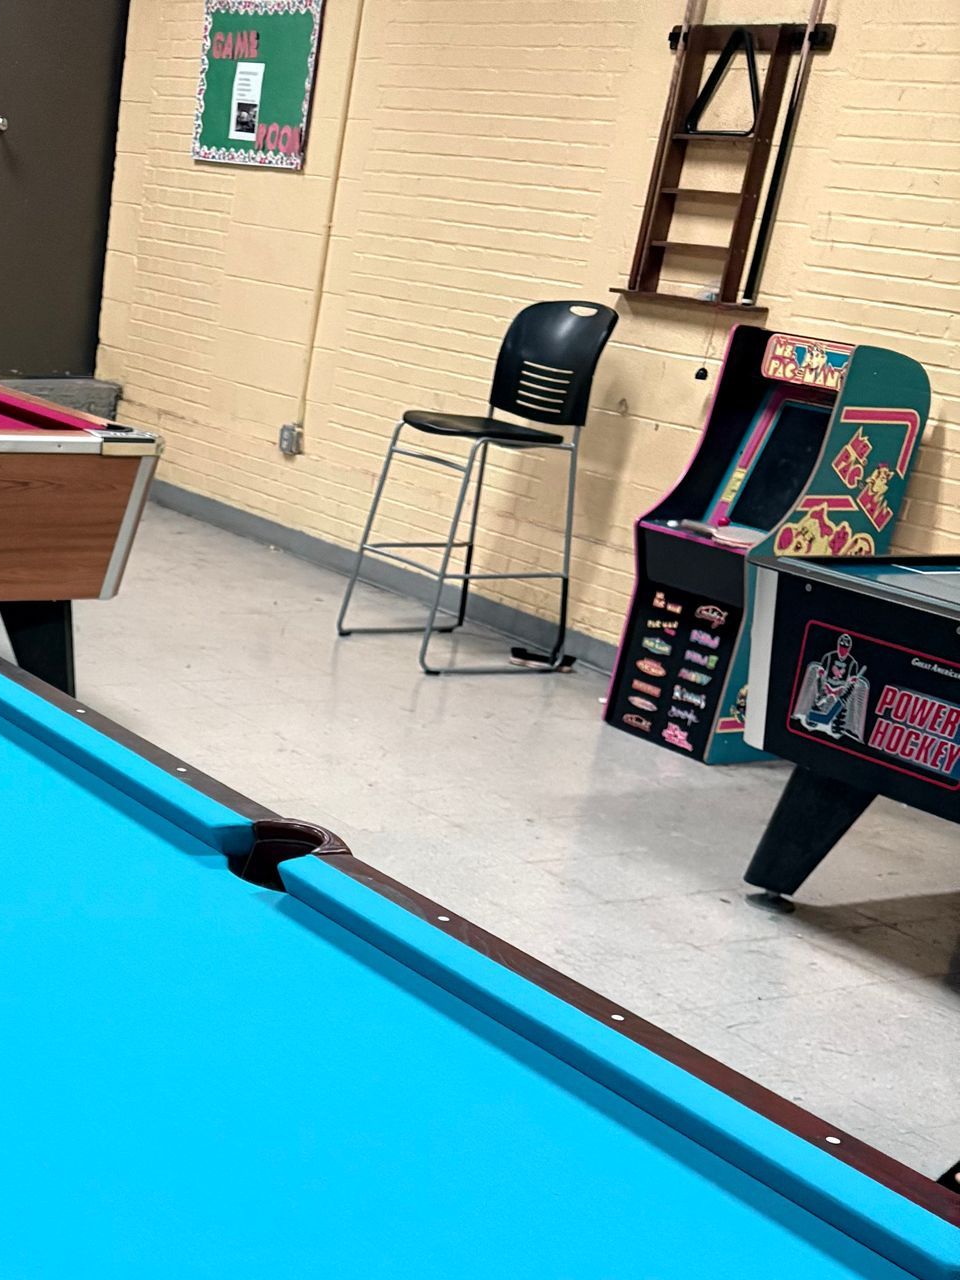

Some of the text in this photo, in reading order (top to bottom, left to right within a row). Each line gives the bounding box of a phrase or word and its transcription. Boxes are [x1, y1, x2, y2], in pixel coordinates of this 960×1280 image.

[212, 31, 258, 60] GAME
[256, 123, 302, 154] ROOM
[875, 684, 960, 739] POWER
[868, 717, 960, 774] HOCKEY
